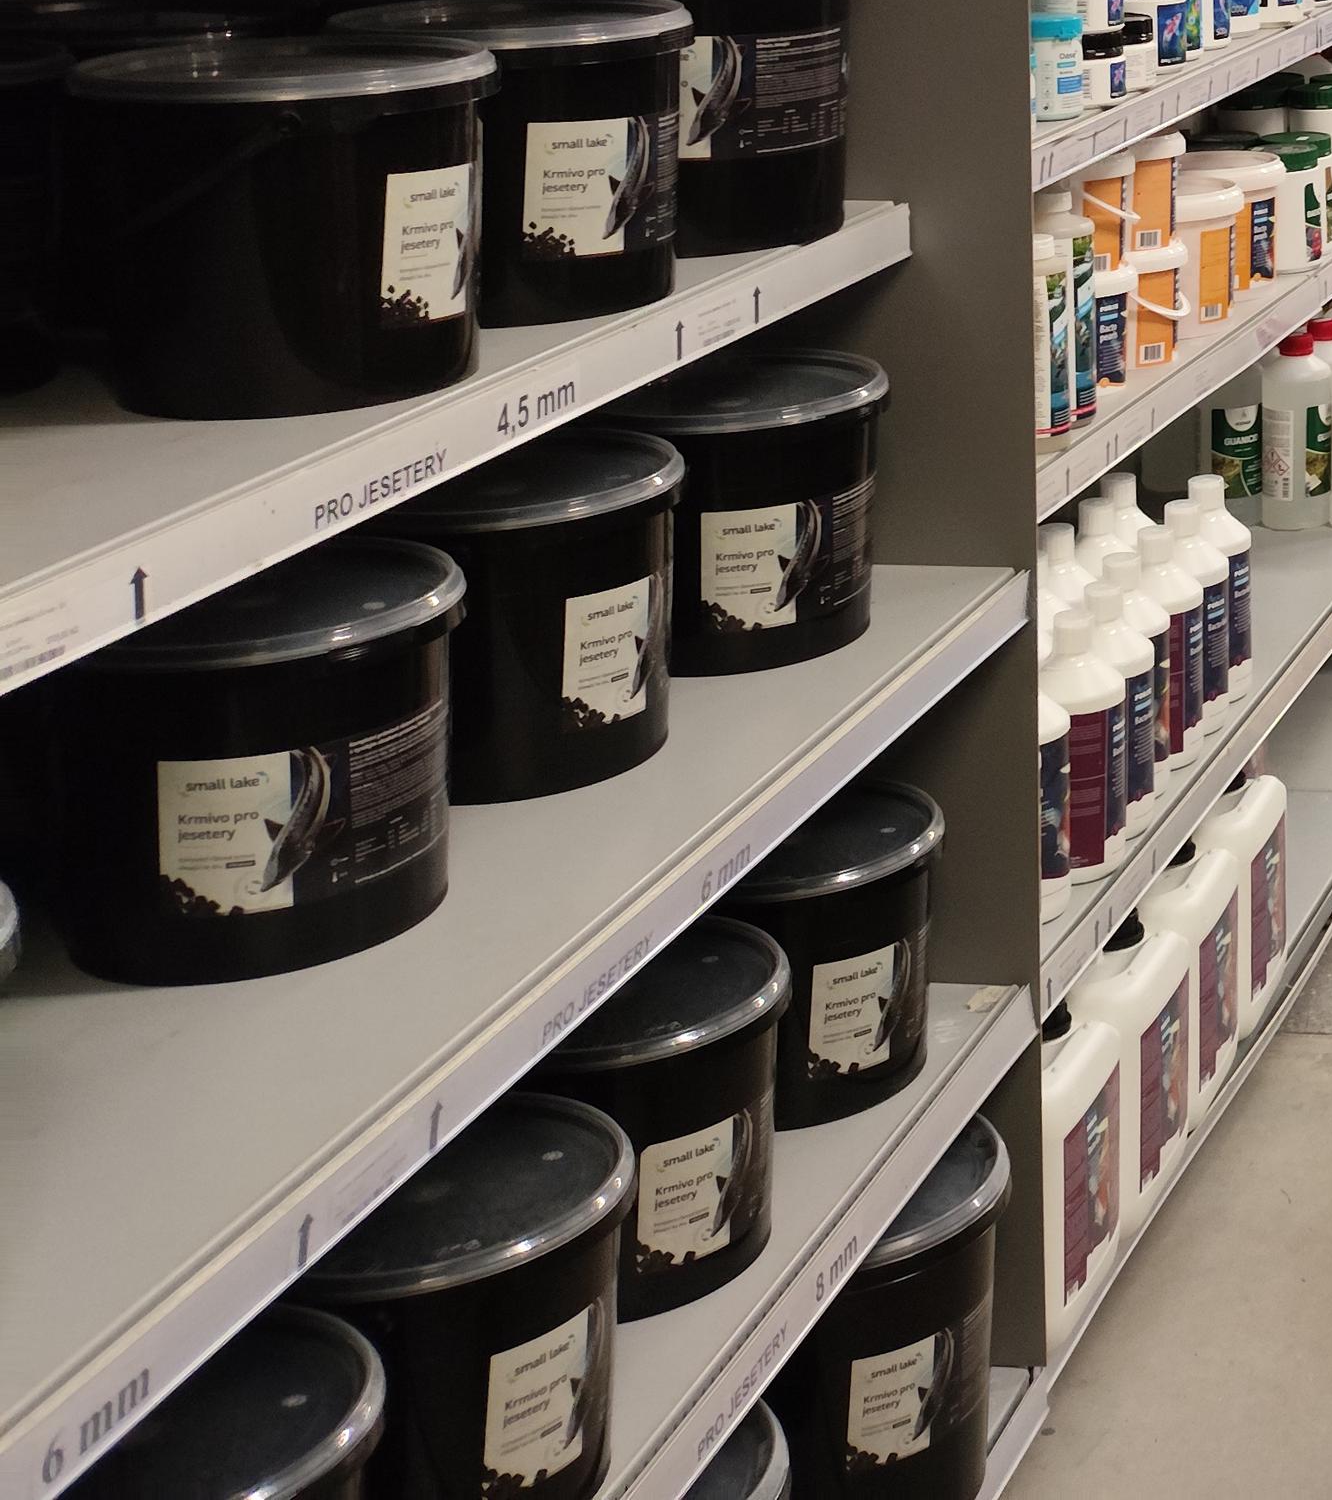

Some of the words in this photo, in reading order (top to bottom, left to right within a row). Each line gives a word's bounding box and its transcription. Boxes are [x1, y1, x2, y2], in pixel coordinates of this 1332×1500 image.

[551, 138, 584, 151] small
[586, 136, 608, 149] lake
[543, 168, 584, 180] Krmivo
[587, 167, 606, 181] pro
[542, 182, 588, 197] jesetery
[497, 387, 529, 436] 4,5
[537, 380, 576, 420] mm
[315, 491, 354, 530] PRO
[359, 448, 449, 509] JESETERY
[722, 524, 751, 537] small
[754, 520, 775, 533] lake
[716, 550, 754, 563] Krmivo
[757, 548, 774, 562] pro
[715, 561, 758, 576] jesetery
[587, 606, 615, 620] small
[617, 600, 634, 615] lake
[580, 636, 616, 652] Krmivo
[619, 629, 633, 645] pro
[579, 646, 619, 666] jesetery
[186, 776, 225, 793] small
[229, 774, 260, 790] lake
[178, 811, 230, 826] Krmivo
[233, 810, 259, 826] pro
[178, 826, 236, 843] jesetery
[701, 872, 712, 902] 6
[717, 844, 751, 889] mm
[832, 972, 857, 986] small
[860, 966, 879, 980] lake
[541, 1001, 577, 1047] PRO
[579, 932, 656, 1011] JESETERY
[825, 997, 857, 1012] Krmivo
[860, 991, 877, 1007] pro
[824, 1007, 863, 1026] jesetery
[663, 1150, 693, 1168] small
[695, 1141, 716, 1159] lake
[655, 1176, 695, 1196] Krmivo
[696, 1170, 714, 1187] pro
[654, 1188, 698, 1211] jesetery
[815, 1270, 826, 1303] 8
[829, 1235, 860, 1288] mm
[696, 1415, 725, 1463] PRO
[726, 1321, 790, 1420] JESETERY
[42, 1428, 64, 1486] 6
[78, 1367, 151, 1456] mm
